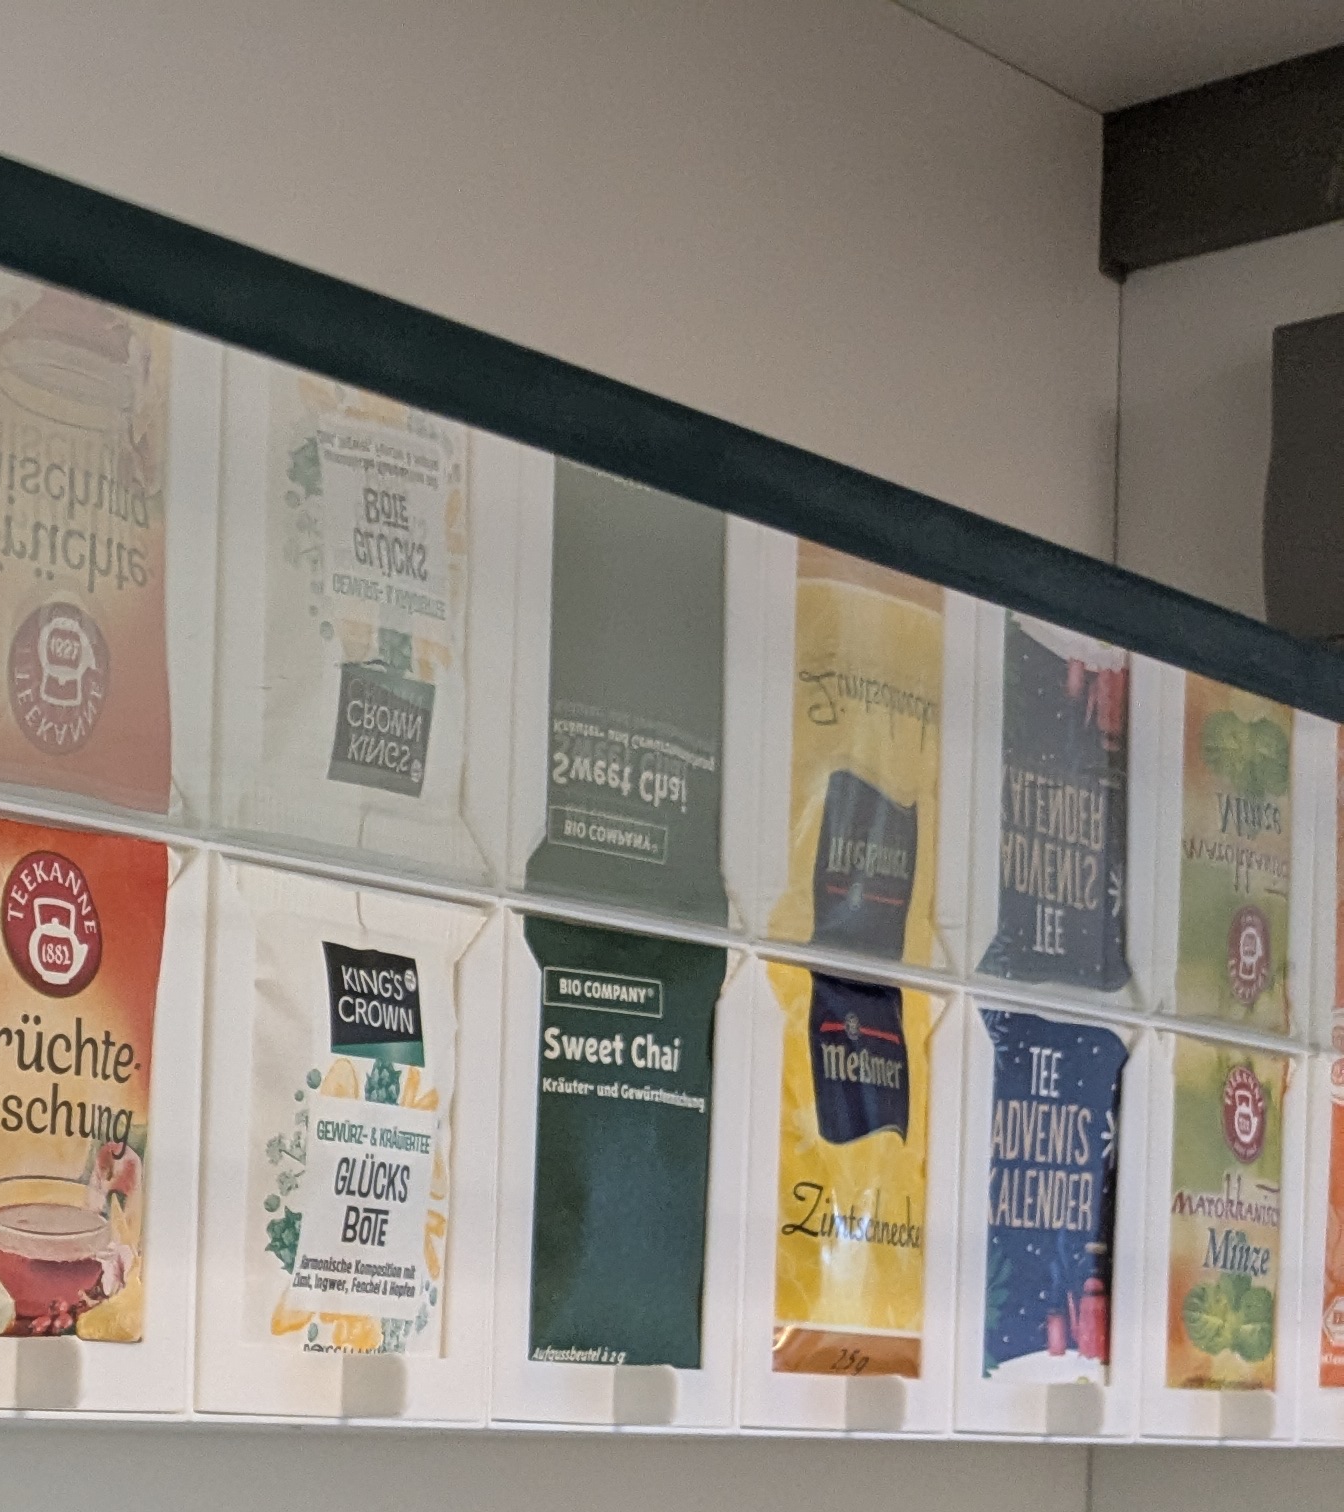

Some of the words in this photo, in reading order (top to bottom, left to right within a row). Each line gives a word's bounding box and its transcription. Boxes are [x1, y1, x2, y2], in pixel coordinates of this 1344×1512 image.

[7, 860, 98, 935] TEEKANNE
[41, 942, 72, 966] 1882
[340, 964, 405, 1001] KING'S
[558, 977, 582, 996] BIO
[338, 995, 416, 1035] CROWN
[542, 1026, 624, 1067] Sweet
[630, 1033, 682, 1073] Chai
[821, 1041, 903, 1090] Meßmer
[1029, 1046, 1063, 1099] TEE
[542, 1077, 595, 1096] Kräuter-
[596, 1081, 620, 1099] und
[991, 1099, 1092, 1167] ADVENTS
[333, 1153, 411, 1203] GLÜCKS
[341, 1205, 390, 1248] BOTE
[1202, 1226, 1272, 1277] Minze
